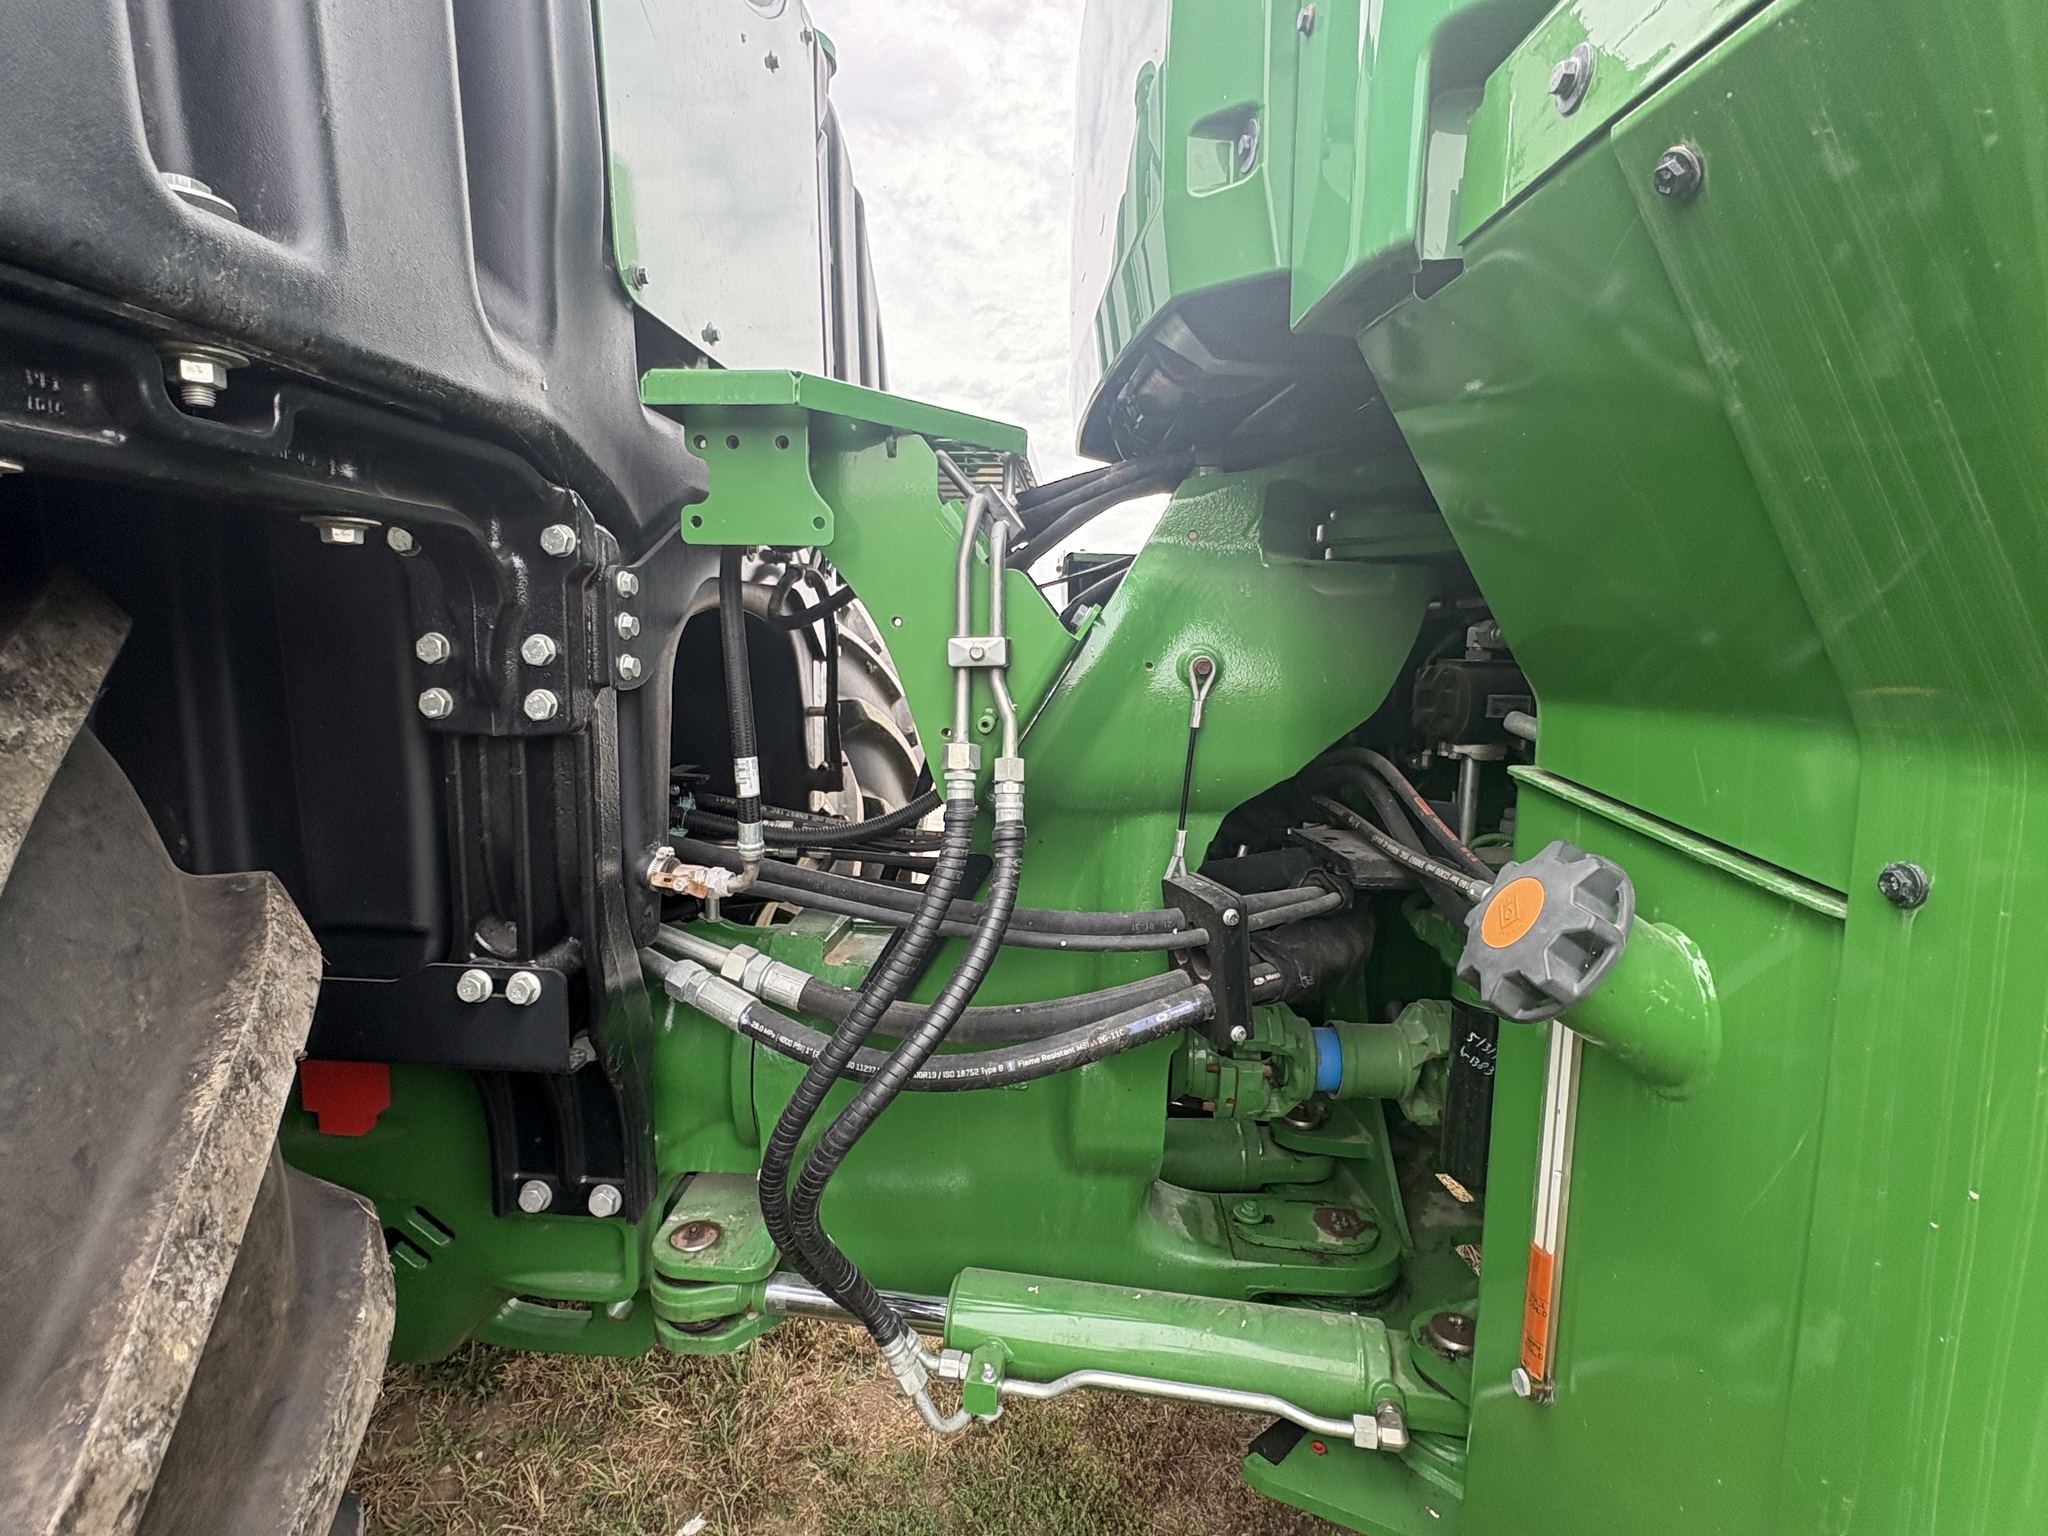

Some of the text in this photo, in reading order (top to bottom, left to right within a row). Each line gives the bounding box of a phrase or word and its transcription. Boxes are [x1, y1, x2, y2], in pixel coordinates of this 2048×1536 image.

[764, 1026, 776, 1039] MPa
[913, 1070, 937, 1080] 00R19
[943, 1070, 955, 1079] ISO
[956, 1068, 979, 1079] 18752
[980, 1066, 997, 1076] Type
[1017, 1054, 1041, 1068] Flame
[1041, 1046, 1076, 1063] Resistant
[1098, 1028, 1126, 1046] 2G-11C
